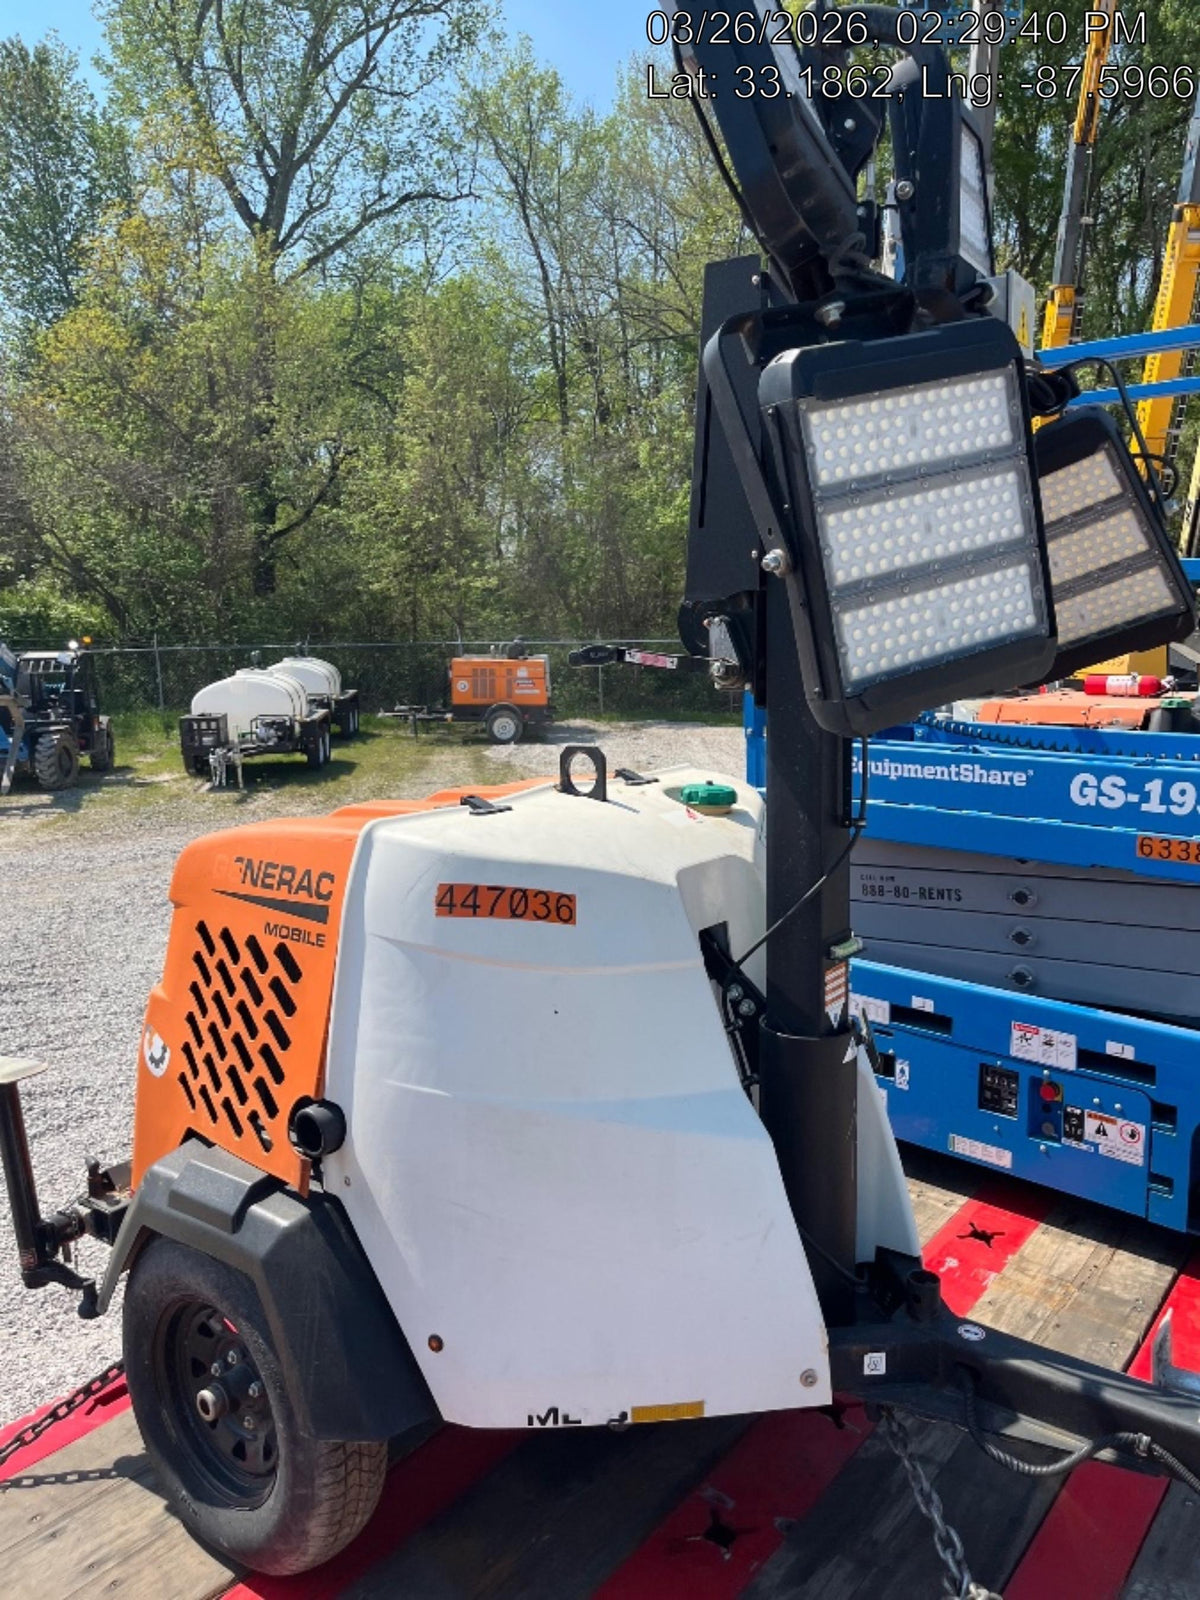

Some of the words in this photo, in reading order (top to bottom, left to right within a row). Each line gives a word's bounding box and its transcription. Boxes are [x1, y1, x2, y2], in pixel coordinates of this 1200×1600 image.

[1070, 773, 1200, 816] GS-19
[436, 884, 574, 923] 447036
[264, 921, 327, 948] MOBILE
